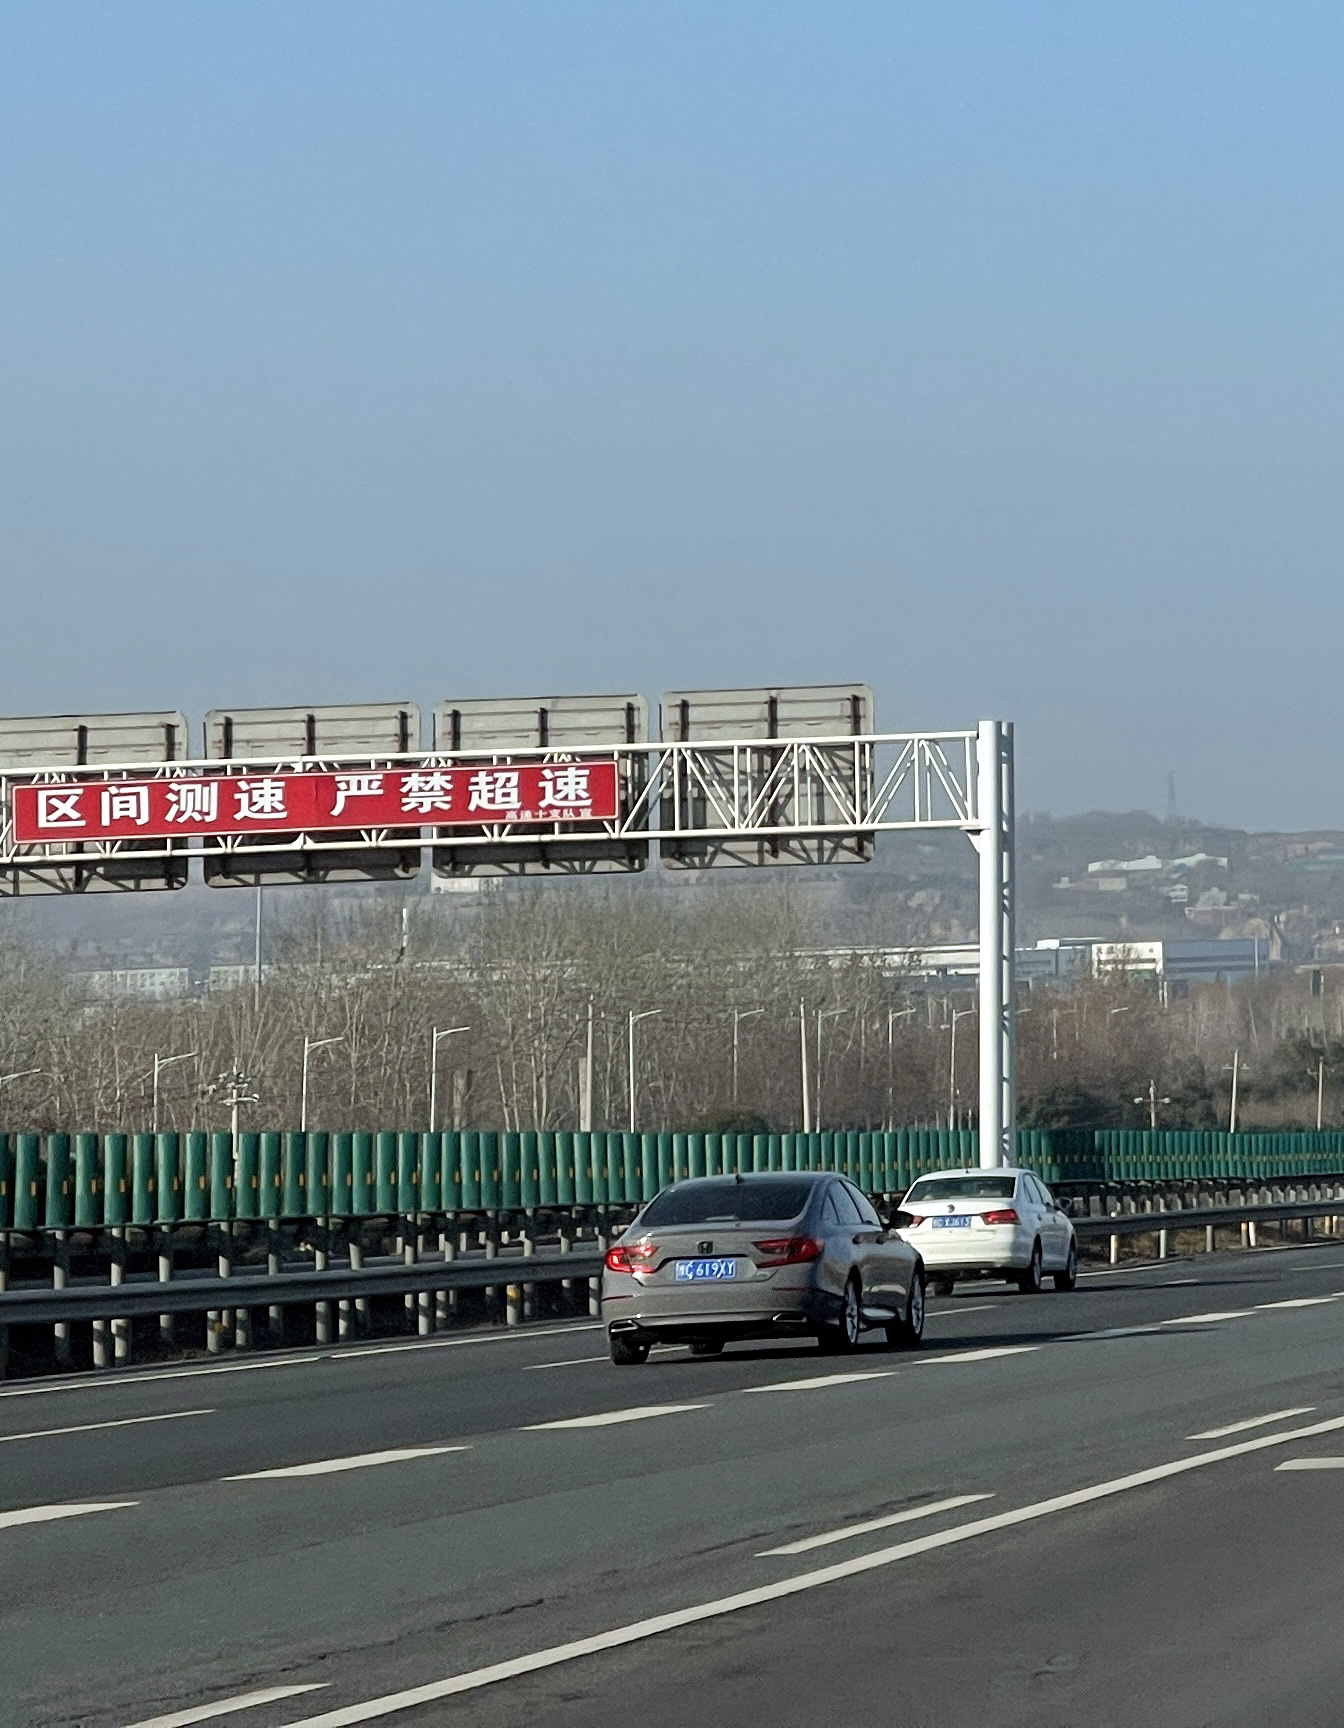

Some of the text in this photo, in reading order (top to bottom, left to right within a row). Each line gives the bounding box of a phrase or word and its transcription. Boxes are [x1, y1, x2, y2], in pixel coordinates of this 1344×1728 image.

[37, 766, 594, 829] 区间测速 严禁超速
